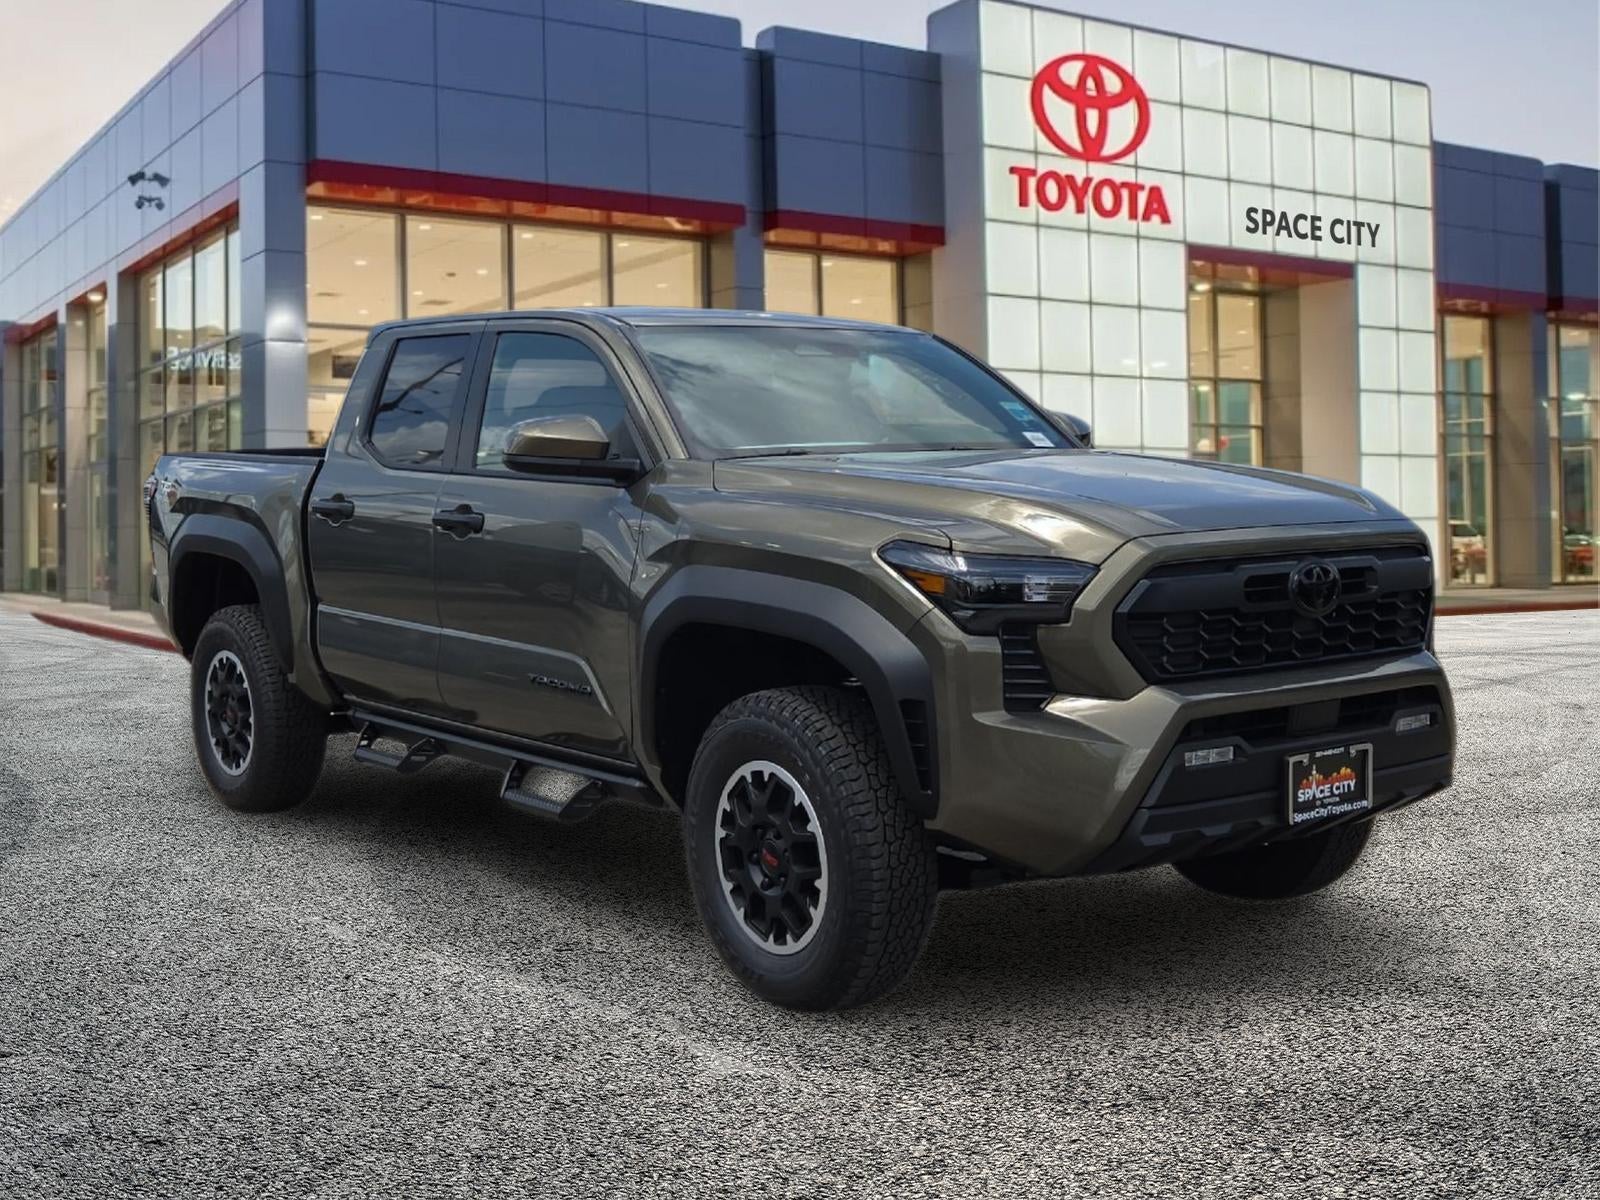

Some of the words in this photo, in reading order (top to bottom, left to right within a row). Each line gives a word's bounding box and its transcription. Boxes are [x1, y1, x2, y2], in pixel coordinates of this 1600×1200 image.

[1009, 166, 1172, 224] TOYOTA
[1245, 206, 1323, 242] SPACE
[1330, 218, 1381, 248] CITY
[528, 672, 593, 695] TACOMA
[1297, 783, 1331, 802] SPACE
[1332, 779, 1356, 796] CITY
[1293, 800, 1369, 823] SpaceCityToyota.com
